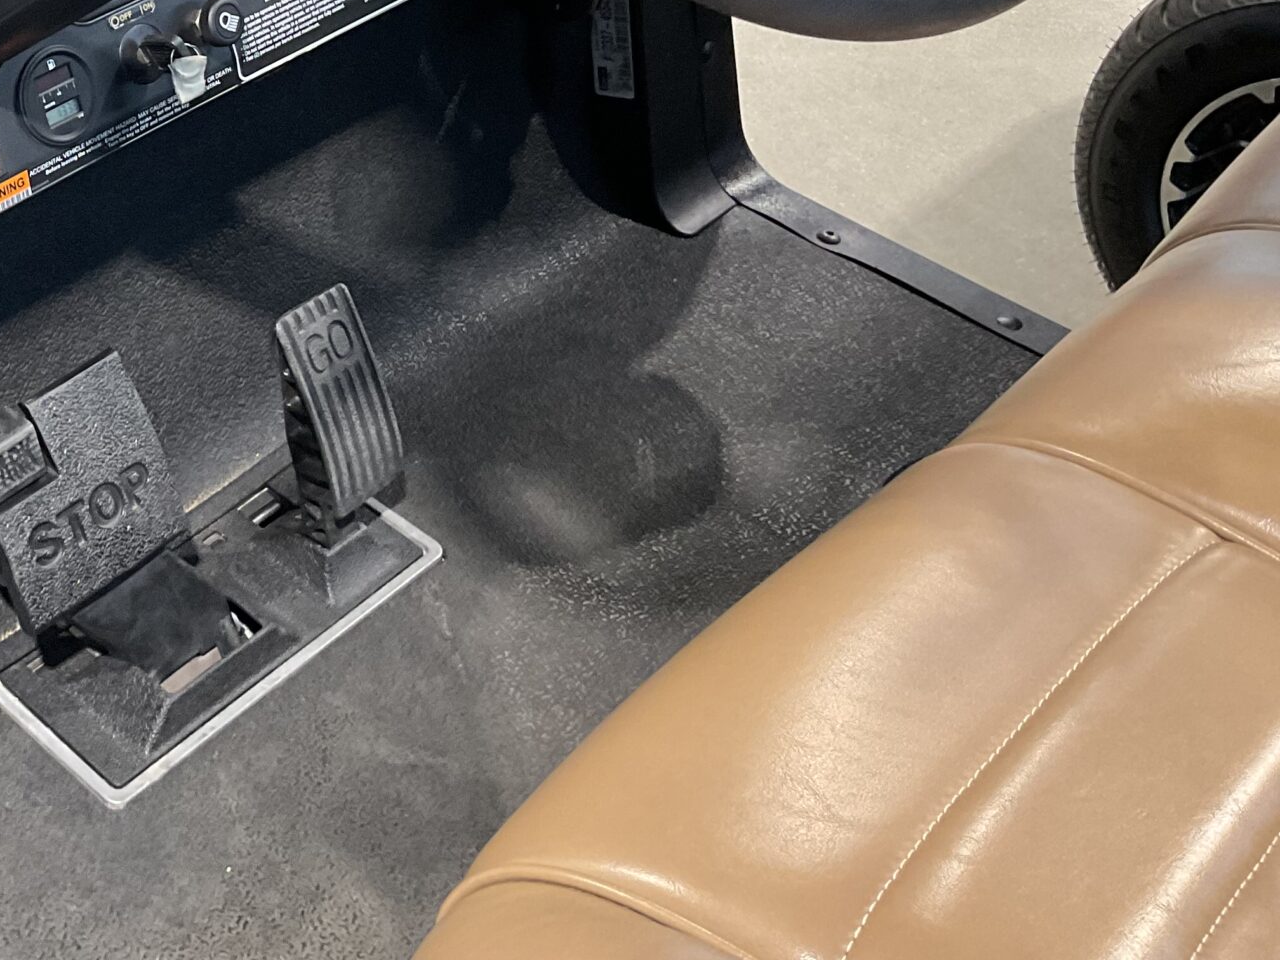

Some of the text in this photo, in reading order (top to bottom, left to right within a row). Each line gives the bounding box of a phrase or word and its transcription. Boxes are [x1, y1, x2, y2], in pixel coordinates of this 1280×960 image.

[29, 155, 63, 177] ACCIDENTAL
[63, 143, 86, 159] VEHICLE
[85, 127, 115, 146] MOVEMENT
[138, 110, 149, 119] MAY
[149, 100, 167, 113] CAUSE
[140, 123, 150, 131] OFF
[305, 320, 354, 373] GO
[29, 461, 149, 566] STOP
